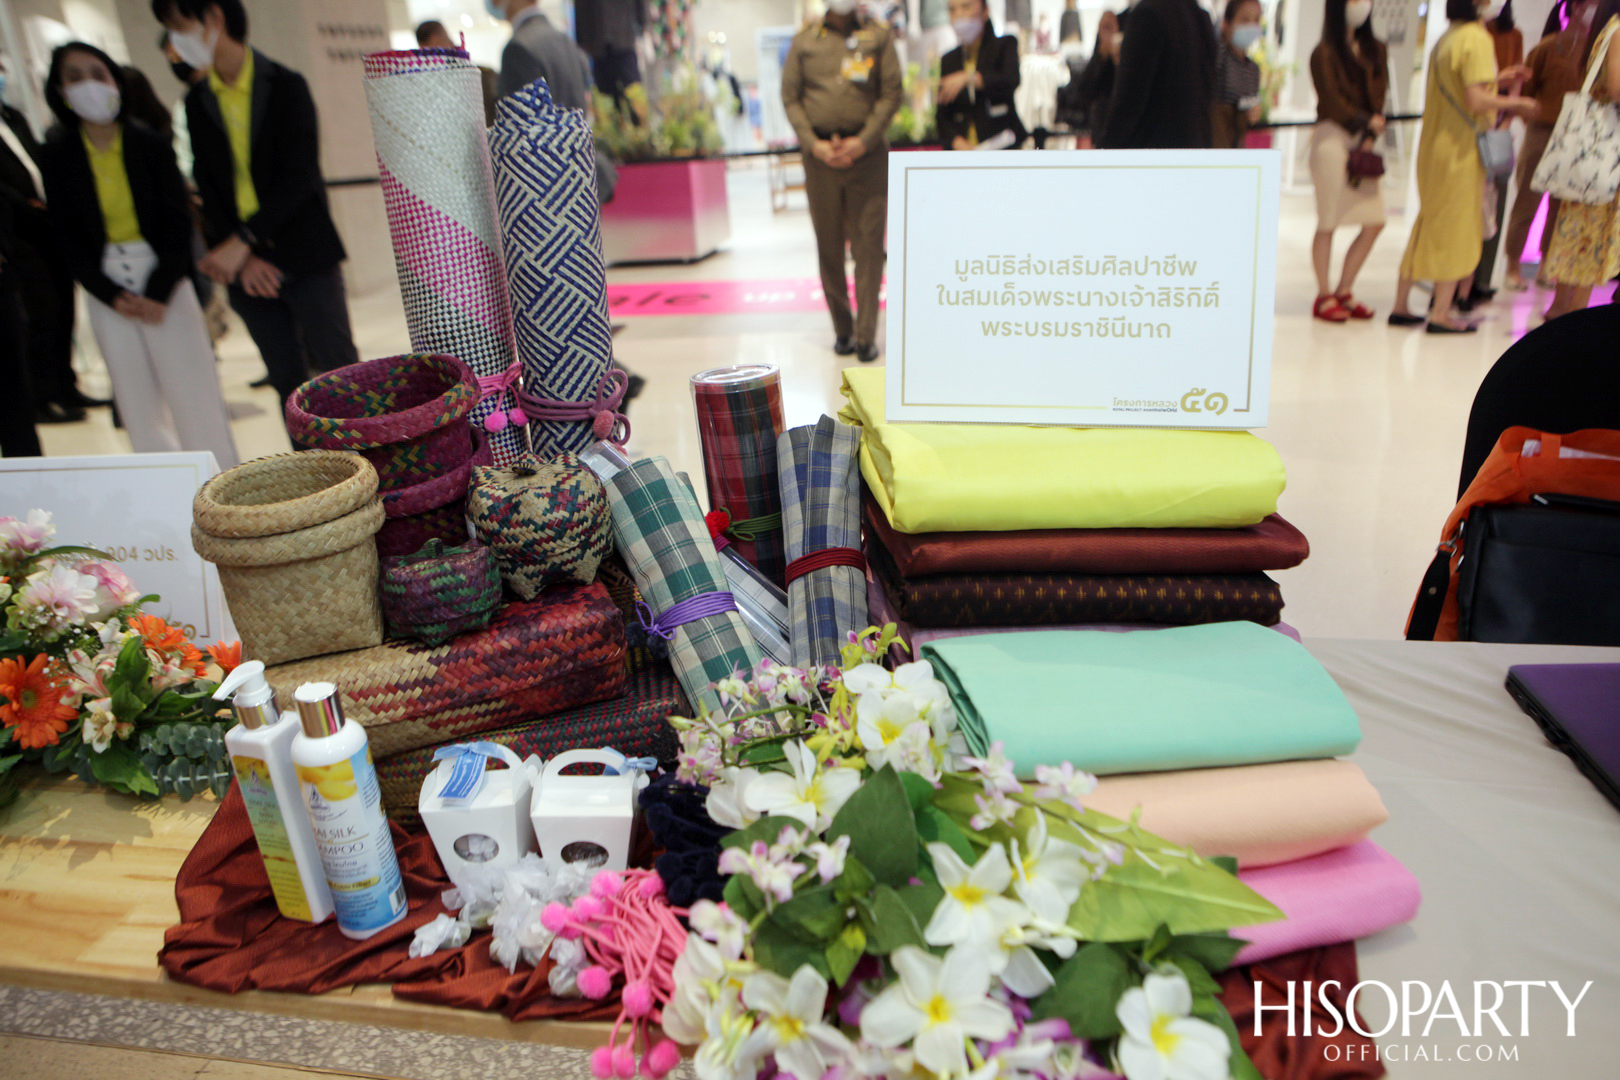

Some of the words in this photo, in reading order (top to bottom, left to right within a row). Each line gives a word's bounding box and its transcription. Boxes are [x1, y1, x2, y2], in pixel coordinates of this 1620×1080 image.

[955, 253, 1198, 282] มูลนิธิส่งเสริมศิลปาชีพ
[936, 281, 1220, 308] ในสมเด็จพระนางเจ้าสิริกิติ์
[981, 316, 1171, 338] พระบรมราชินีนาถ
[1112, 396, 1178, 408] โครงการหลวง
[1180, 387, 1229, 416] ๕๑
[143, 544, 179, 562] วปร.
[328, 825, 357, 841] SILK
[316, 841, 364, 857] AMPOO
